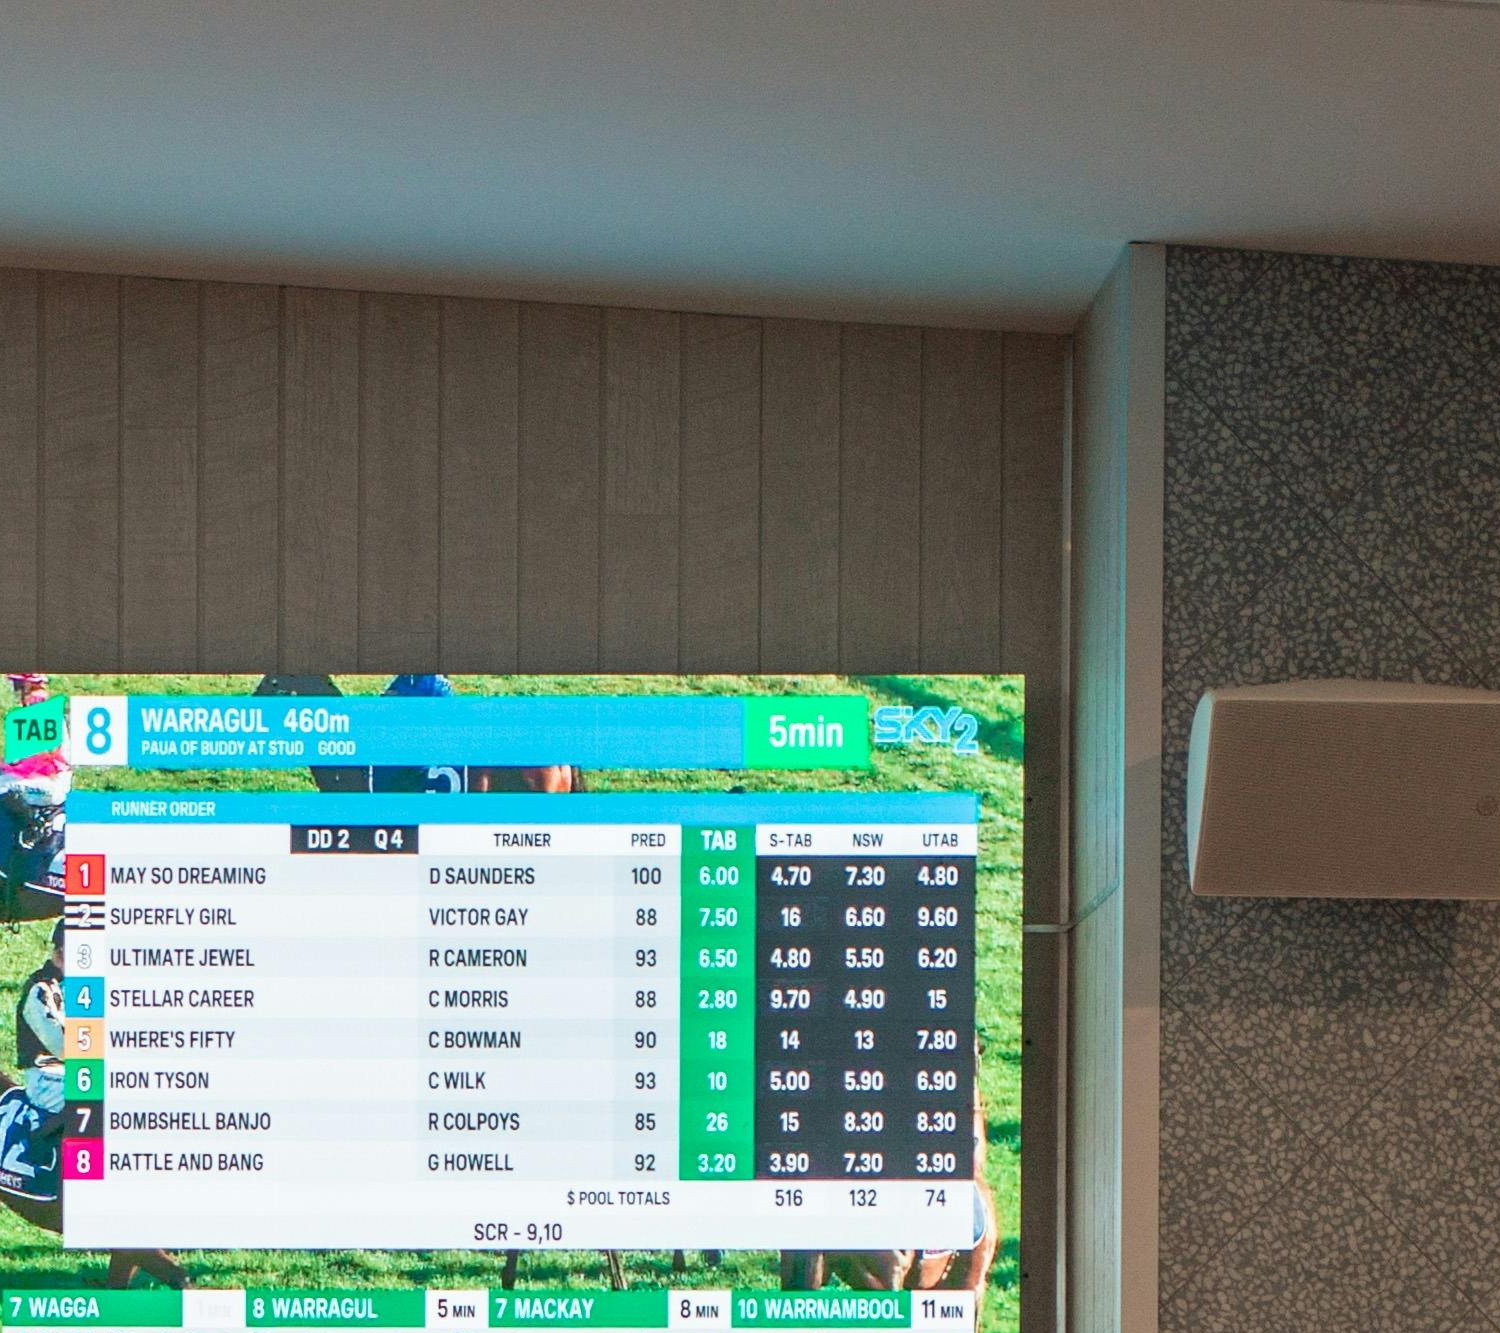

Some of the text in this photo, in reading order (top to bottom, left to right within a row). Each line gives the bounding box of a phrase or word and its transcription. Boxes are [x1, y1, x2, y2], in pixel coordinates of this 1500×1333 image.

[14, 706, 112, 755] TAB 8
[142, 709, 349, 733] WARRAGUL 460m
[769, 715, 843, 749] 5min
[142, 741, 355, 756] PAUA OF BUDDY AT STUD GOOD
[112, 801, 215, 817] RUNNER ORDER
[111, 867, 739, 885] MAY SO DREAMING D SAUNDERS 100 6.00
[111, 949, 527, 968] ULTIMATE JEWEL CAMERON
[111, 990, 509, 1008] STELLAR CAREER MORRIS
[110, 1112, 520, 1131] BOMBSHELL BANJO COLPOYS
